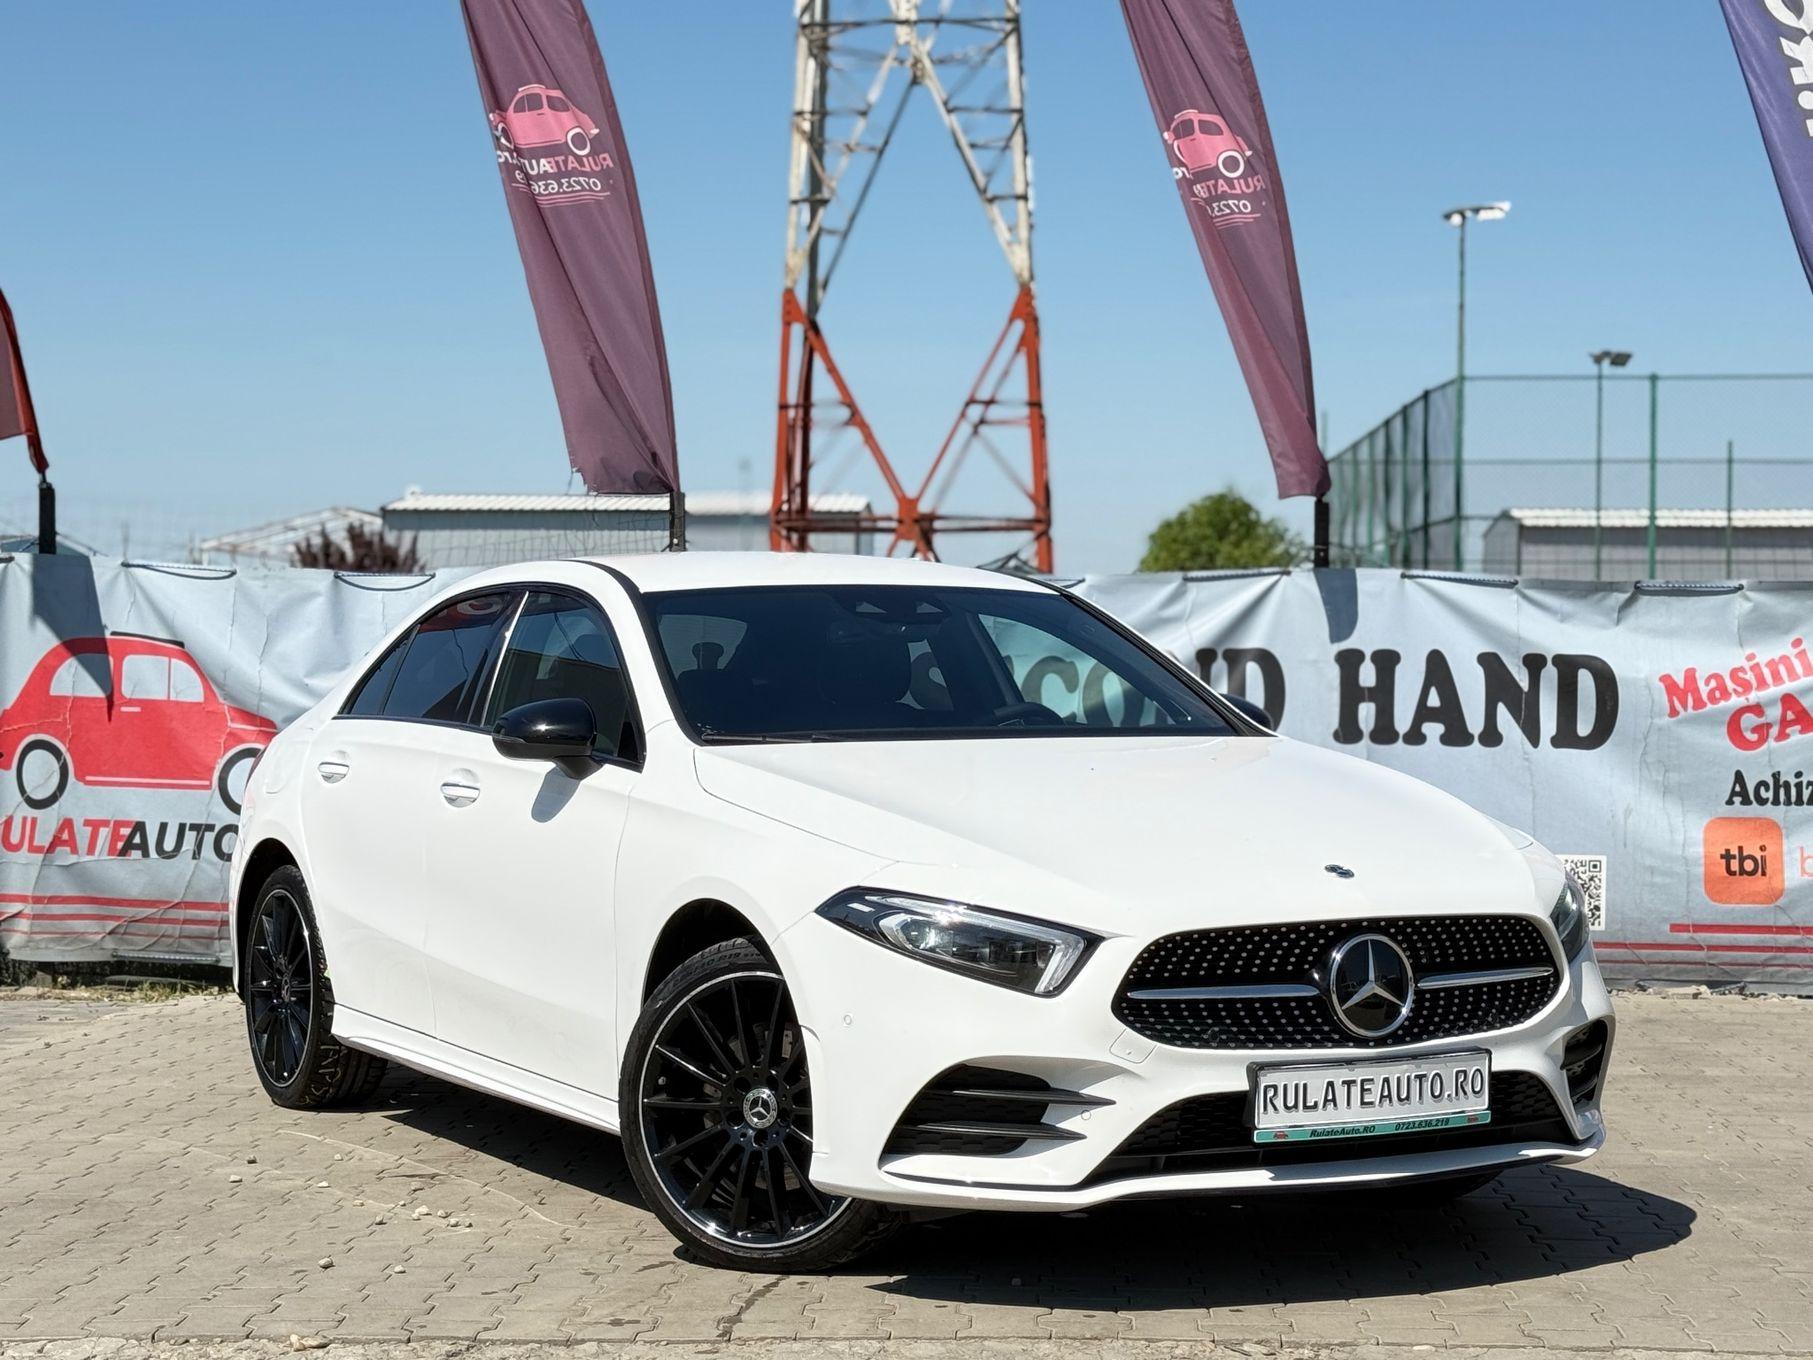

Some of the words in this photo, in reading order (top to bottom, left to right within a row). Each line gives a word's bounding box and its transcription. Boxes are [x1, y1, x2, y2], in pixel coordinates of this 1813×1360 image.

[1333, 648, 1619, 750] HAND
[1720, 844, 1767, 877] tbi
[1262, 1068, 1484, 1113] RULATEAUTO.RO
